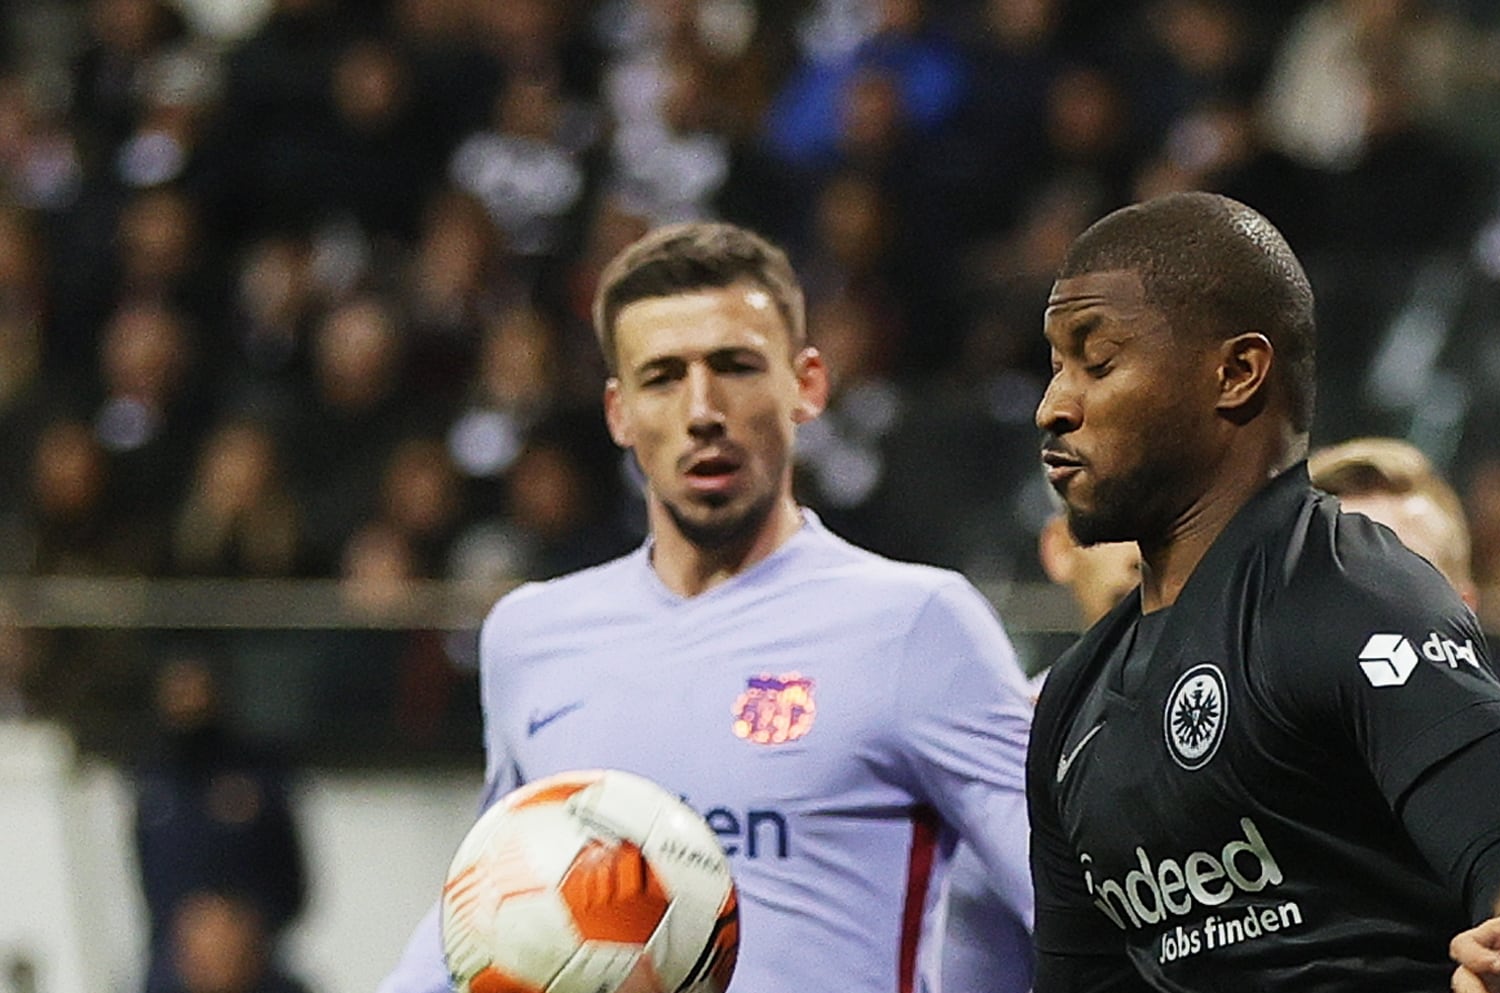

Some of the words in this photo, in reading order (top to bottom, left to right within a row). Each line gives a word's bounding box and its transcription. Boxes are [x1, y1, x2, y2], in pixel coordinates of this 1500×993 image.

[1421, 631, 1480, 669] dpd
[1080, 816, 1284, 930] indeed
[1159, 925, 1201, 964] Jobs
[1203, 901, 1304, 949] finden
